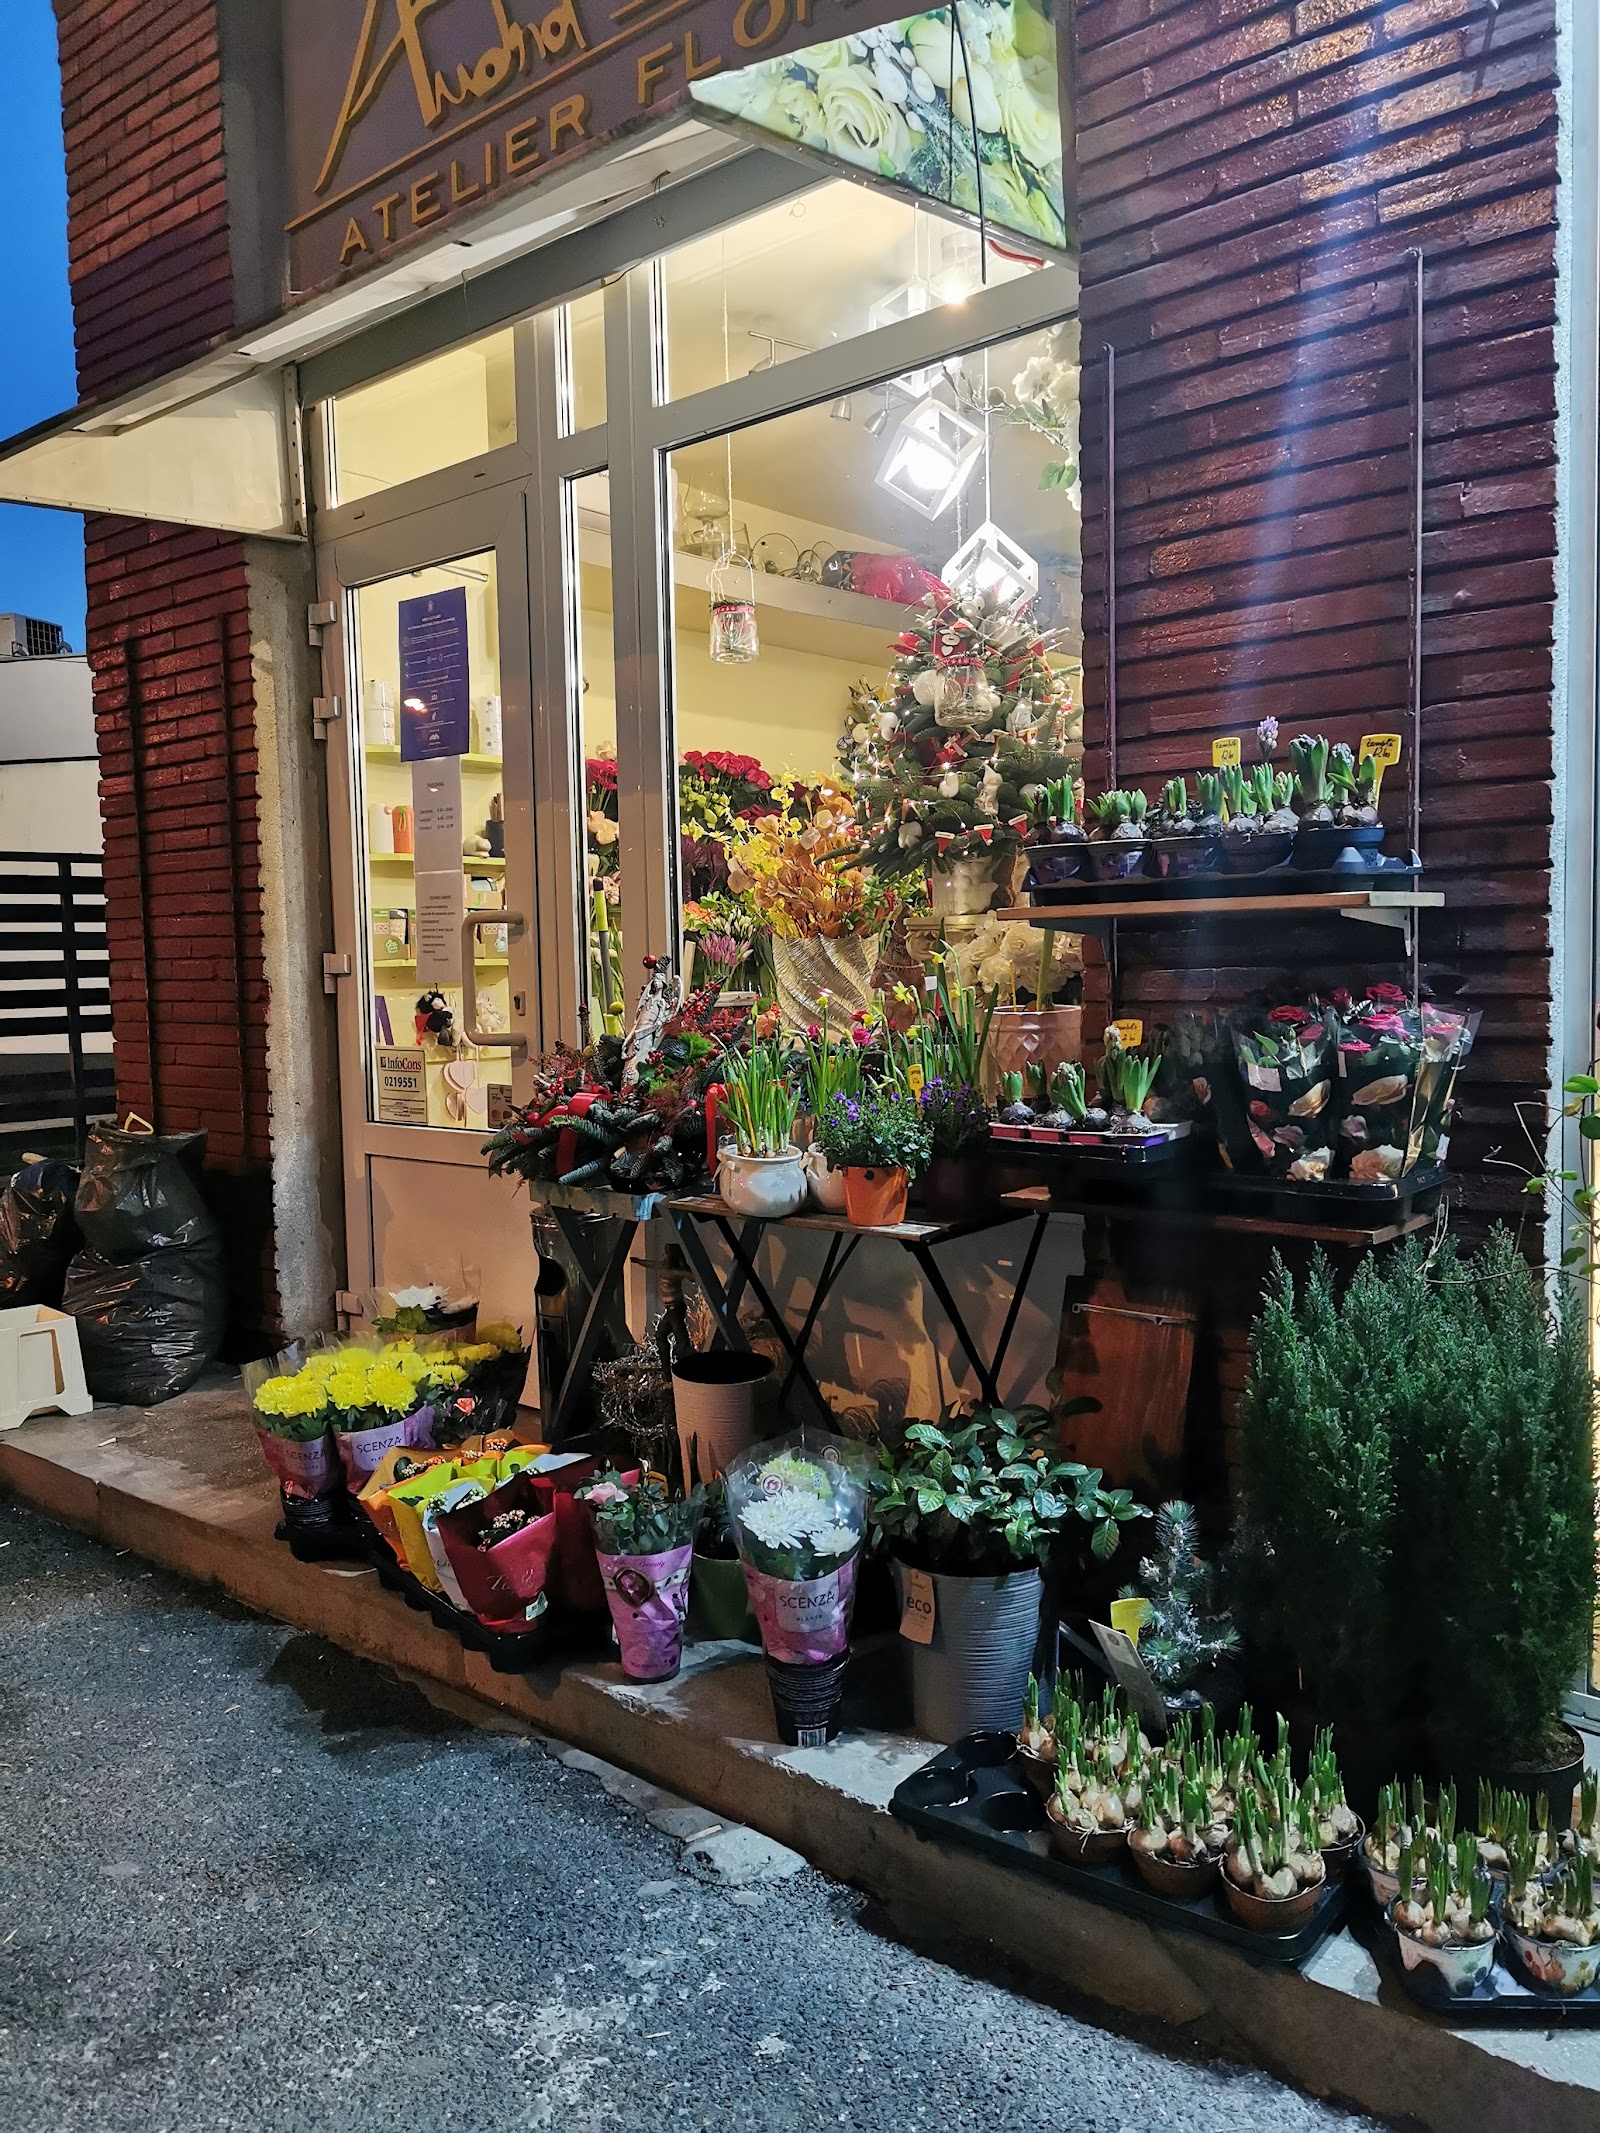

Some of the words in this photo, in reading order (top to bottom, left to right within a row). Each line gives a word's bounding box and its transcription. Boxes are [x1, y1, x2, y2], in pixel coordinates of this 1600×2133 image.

[338, 94, 586, 265] ATELIER
[387, 1056, 422, 1070] InfoCons
[384, 1076, 417, 1088] 0219551
[357, 1436, 402, 1455] SCENZA
[779, 1591, 835, 1609] SCENZA
[906, 1597, 932, 1614] eco
